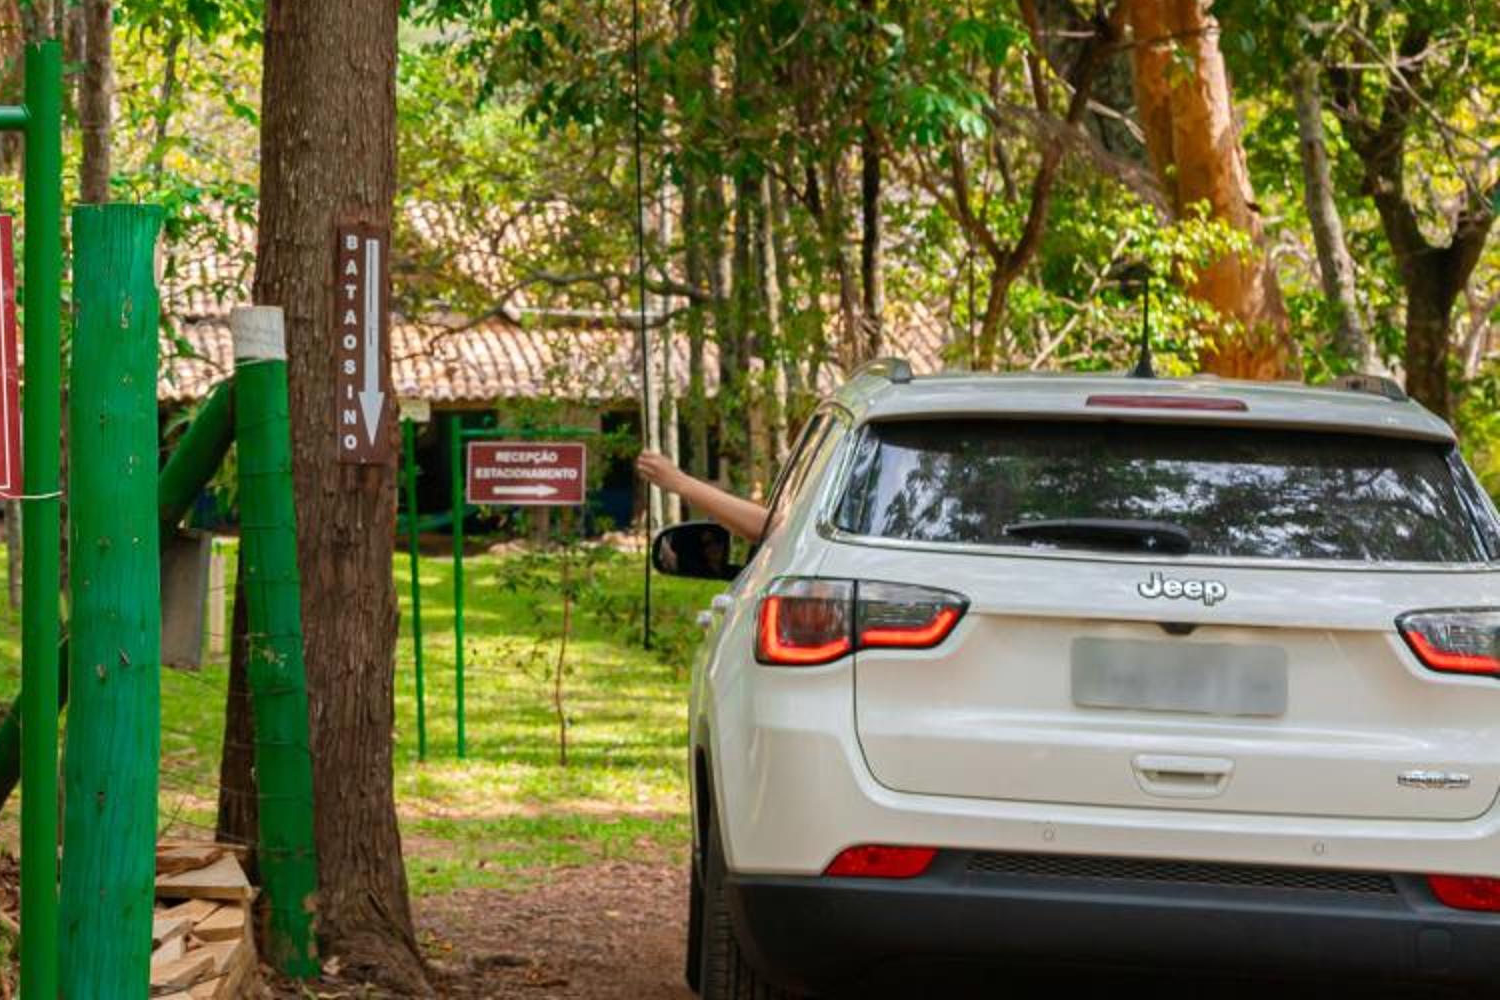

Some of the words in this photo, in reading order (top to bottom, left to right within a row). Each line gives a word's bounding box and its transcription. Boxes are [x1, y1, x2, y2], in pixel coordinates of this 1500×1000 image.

[495, 450, 558, 464] RECEPÇÃO
[475, 467, 578, 480] ESTACIONAMENTO
[1137, 571, 1227, 607] Jeep
